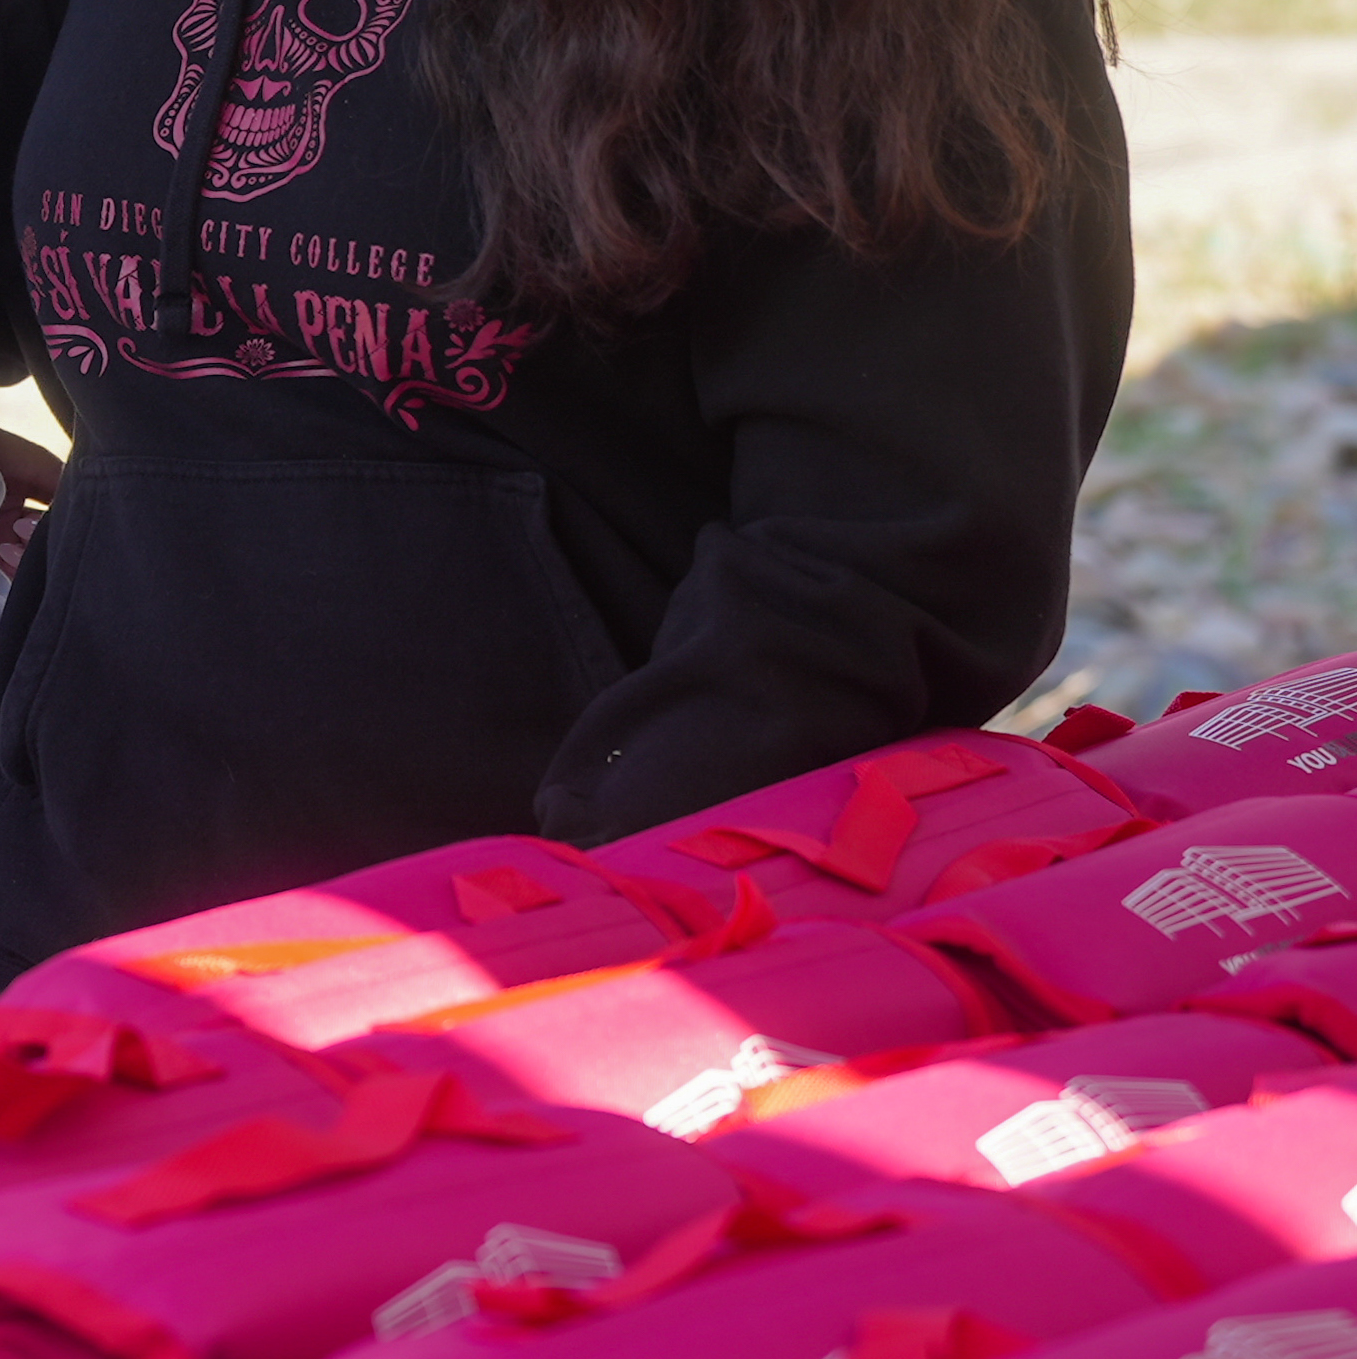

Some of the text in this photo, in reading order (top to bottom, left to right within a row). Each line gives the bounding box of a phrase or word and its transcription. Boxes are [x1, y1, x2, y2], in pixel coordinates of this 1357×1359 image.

[40, 188, 436, 287] SAN DIEG CITY COLLEGE
[1286, 746, 1338, 774] YOU
